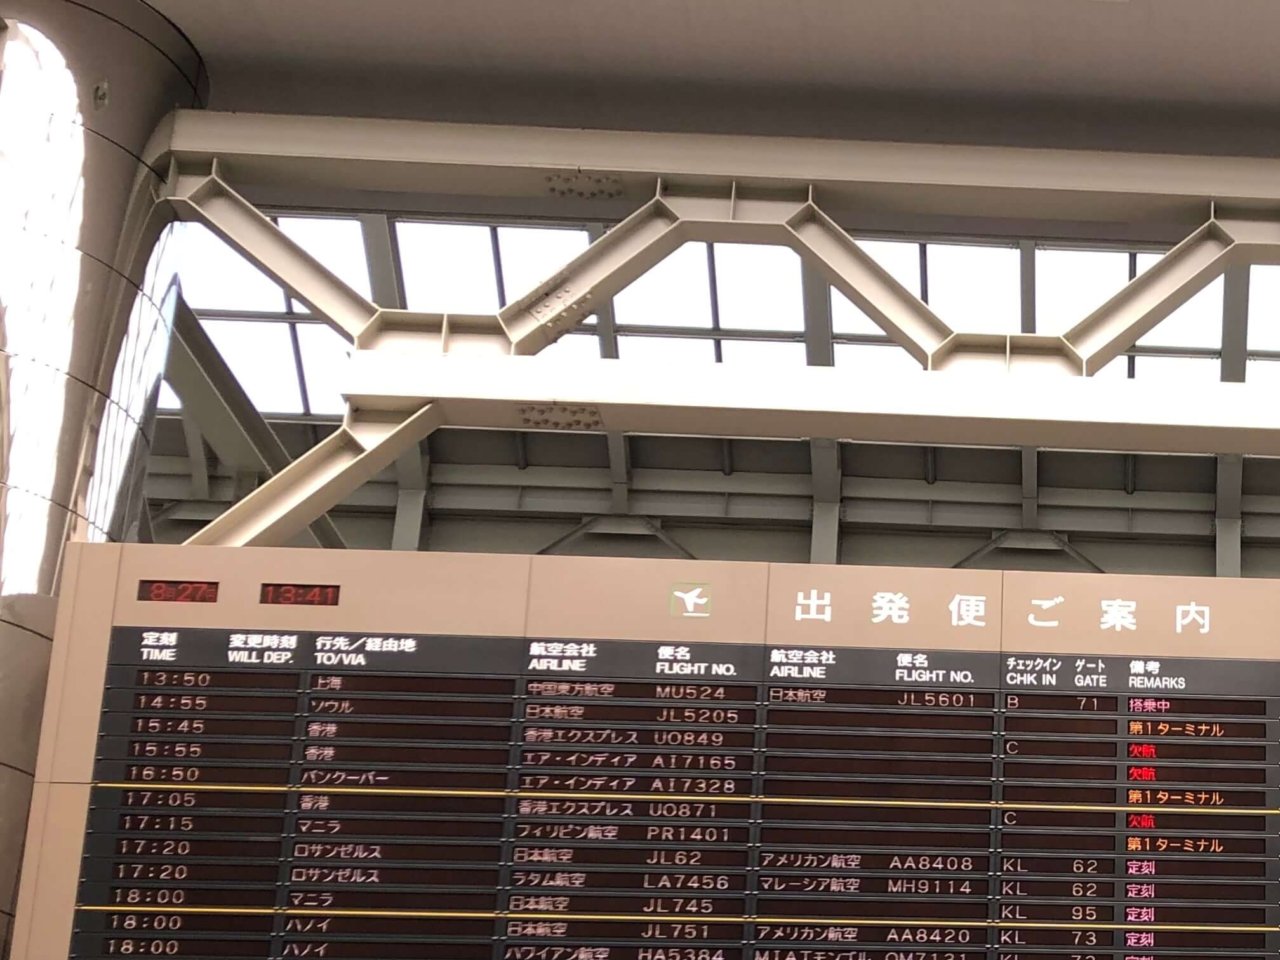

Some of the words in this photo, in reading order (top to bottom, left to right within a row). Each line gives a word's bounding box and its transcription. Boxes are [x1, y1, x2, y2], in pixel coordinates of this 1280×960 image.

[264, 585, 336, 604] 13:41
[794, 588, 1211, 634] 出発便ご案内
[141, 648, 176, 662] TIME
[228, 650, 261, 664] WILL
[263, 651, 294, 665] DEP.
[314, 652, 366, 666] TO/VIA
[528, 658, 587, 672] AIRLINE
[655, 661, 710, 675] FLIGHT
[711, 663, 737, 676] NO.
[769, 665, 826, 679] AIRLINE
[895, 669, 947, 683] FLIGHT
[949, 670, 975, 684] NO.
[1006, 672, 1038, 686] CHK
[1041, 673, 1057, 686] IN
[1074, 674, 1107, 688] GATE
[1128, 675, 1186, 690] REMARKS
[142, 631, 177, 648] 定刻
[228, 634, 298, 650] 変更時刻
[529, 642, 597, 658] 航空会社
[657, 645, 691, 661] 便名
[769, 649, 836, 665] 航空会社
[896, 653, 929, 668] 便名
[1006, 656, 1062, 671] チェックイン
[1074, 658, 1107, 673] ゲート
[1129, 660, 1161, 675] 備考
[141, 671, 211, 688] 13:50
[313, 676, 343, 691] 上海
[656, 685, 726, 700] MU524
[769, 687, 827, 704] 日本航空
[898, 692, 976, 708] JL5601
[1007, 695, 1019, 709] B
[1076, 696, 1099, 711] 71
[135, 718, 205, 733] 15:45
[307, 722, 338, 738] 香港
[524, 728, 638, 744] 香港エクスプレス
[654, 731, 724, 746] UO849
[1006, 740, 1018, 755] C
[1128, 744, 1157, 759] 欠航
[130, 766, 200, 782] 16:50
[301, 770, 390, 785] バンクーバー
[650, 778, 736, 794] AI7328
[120, 840, 190, 855] 17:20
[294, 844, 382, 859] ロサンゼルス
[513, 848, 573, 864] 日本航空
[646, 850, 702, 865] JL62
[761, 853, 862, 869] アメリカン航空
[889, 855, 973, 871] AA8408
[1003, 858, 1029, 873] KL
[1072, 859, 1098, 874] 62
[1126, 859, 1156, 875] 定刻
[108, 939, 179, 955] 18:00
[281, 943, 328, 957] ハノイ
